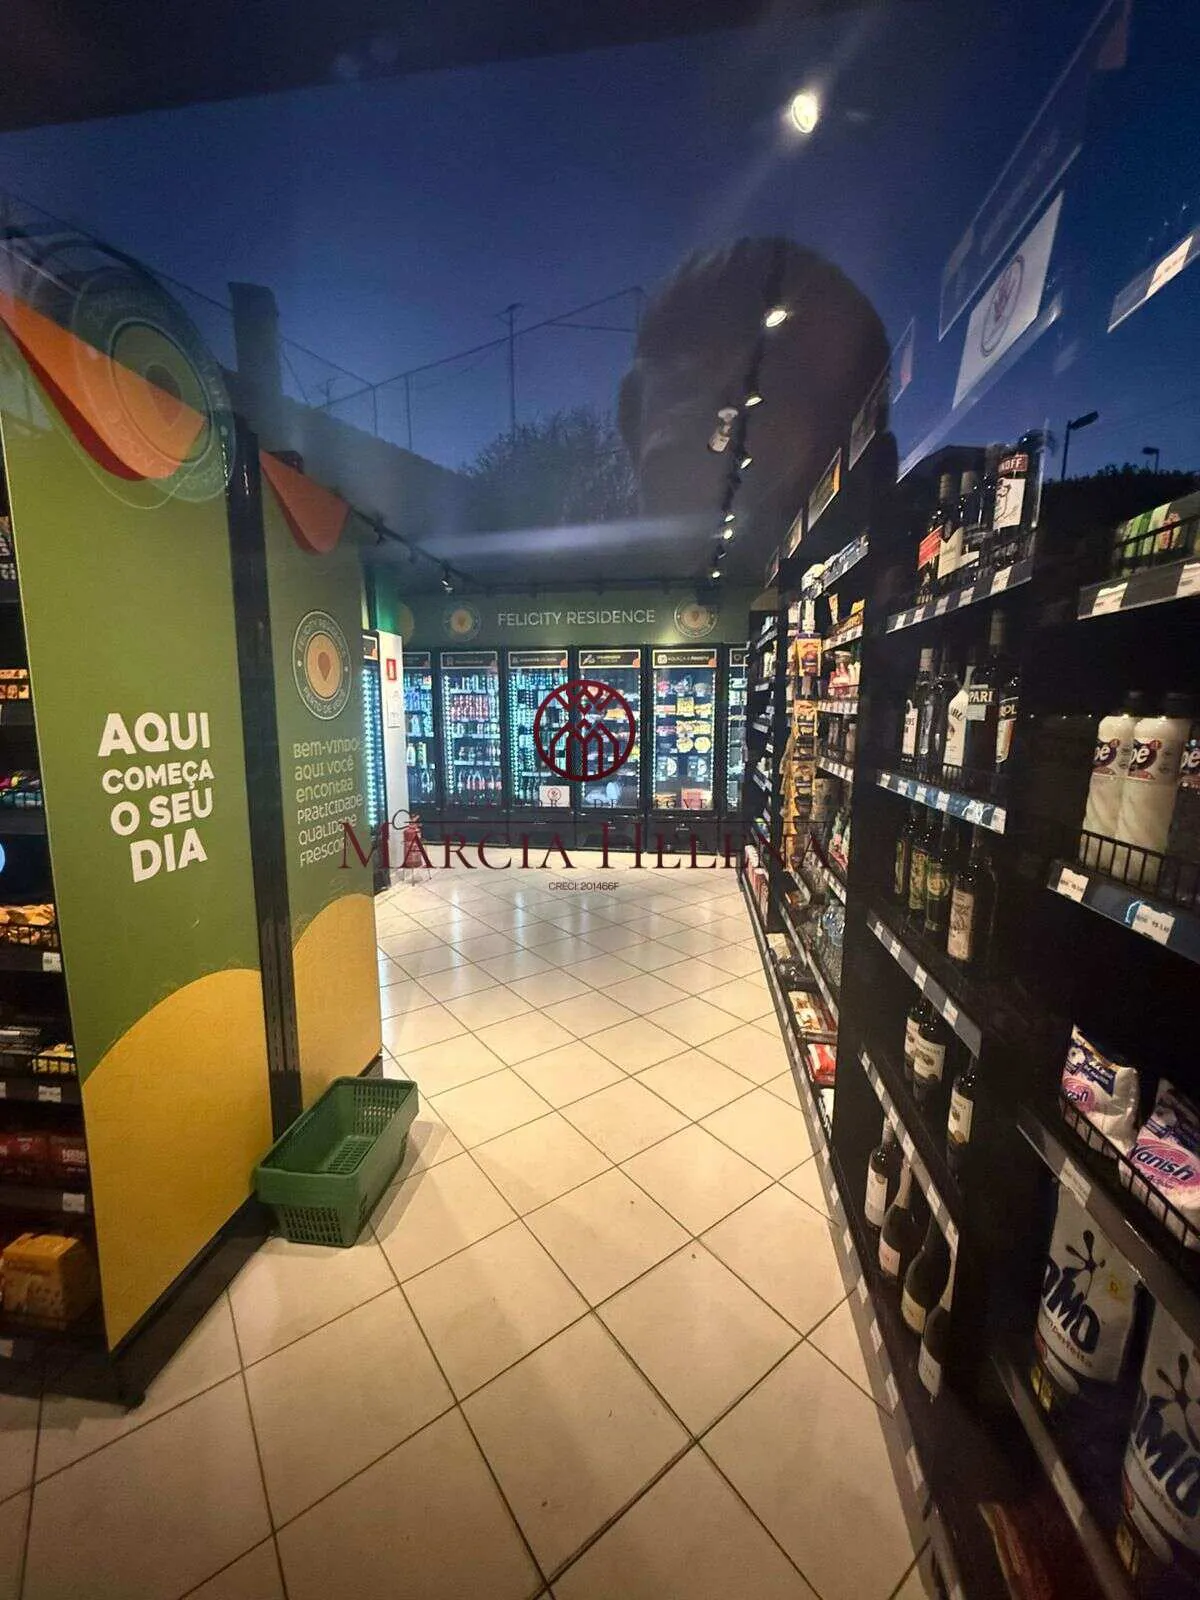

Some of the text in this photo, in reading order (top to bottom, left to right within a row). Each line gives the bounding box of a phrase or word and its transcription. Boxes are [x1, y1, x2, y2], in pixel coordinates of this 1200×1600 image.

[497, 611, 562, 627] FELICITY
[568, 609, 656, 625] RESIDENCE
[98, 712, 210, 757] AQUI
[102, 759, 216, 795] COMEÇA
[327, 754, 354, 775] você
[296, 777, 353, 803] encontra
[110, 788, 214, 836] O SEU
[130, 828, 208, 883] DIA
